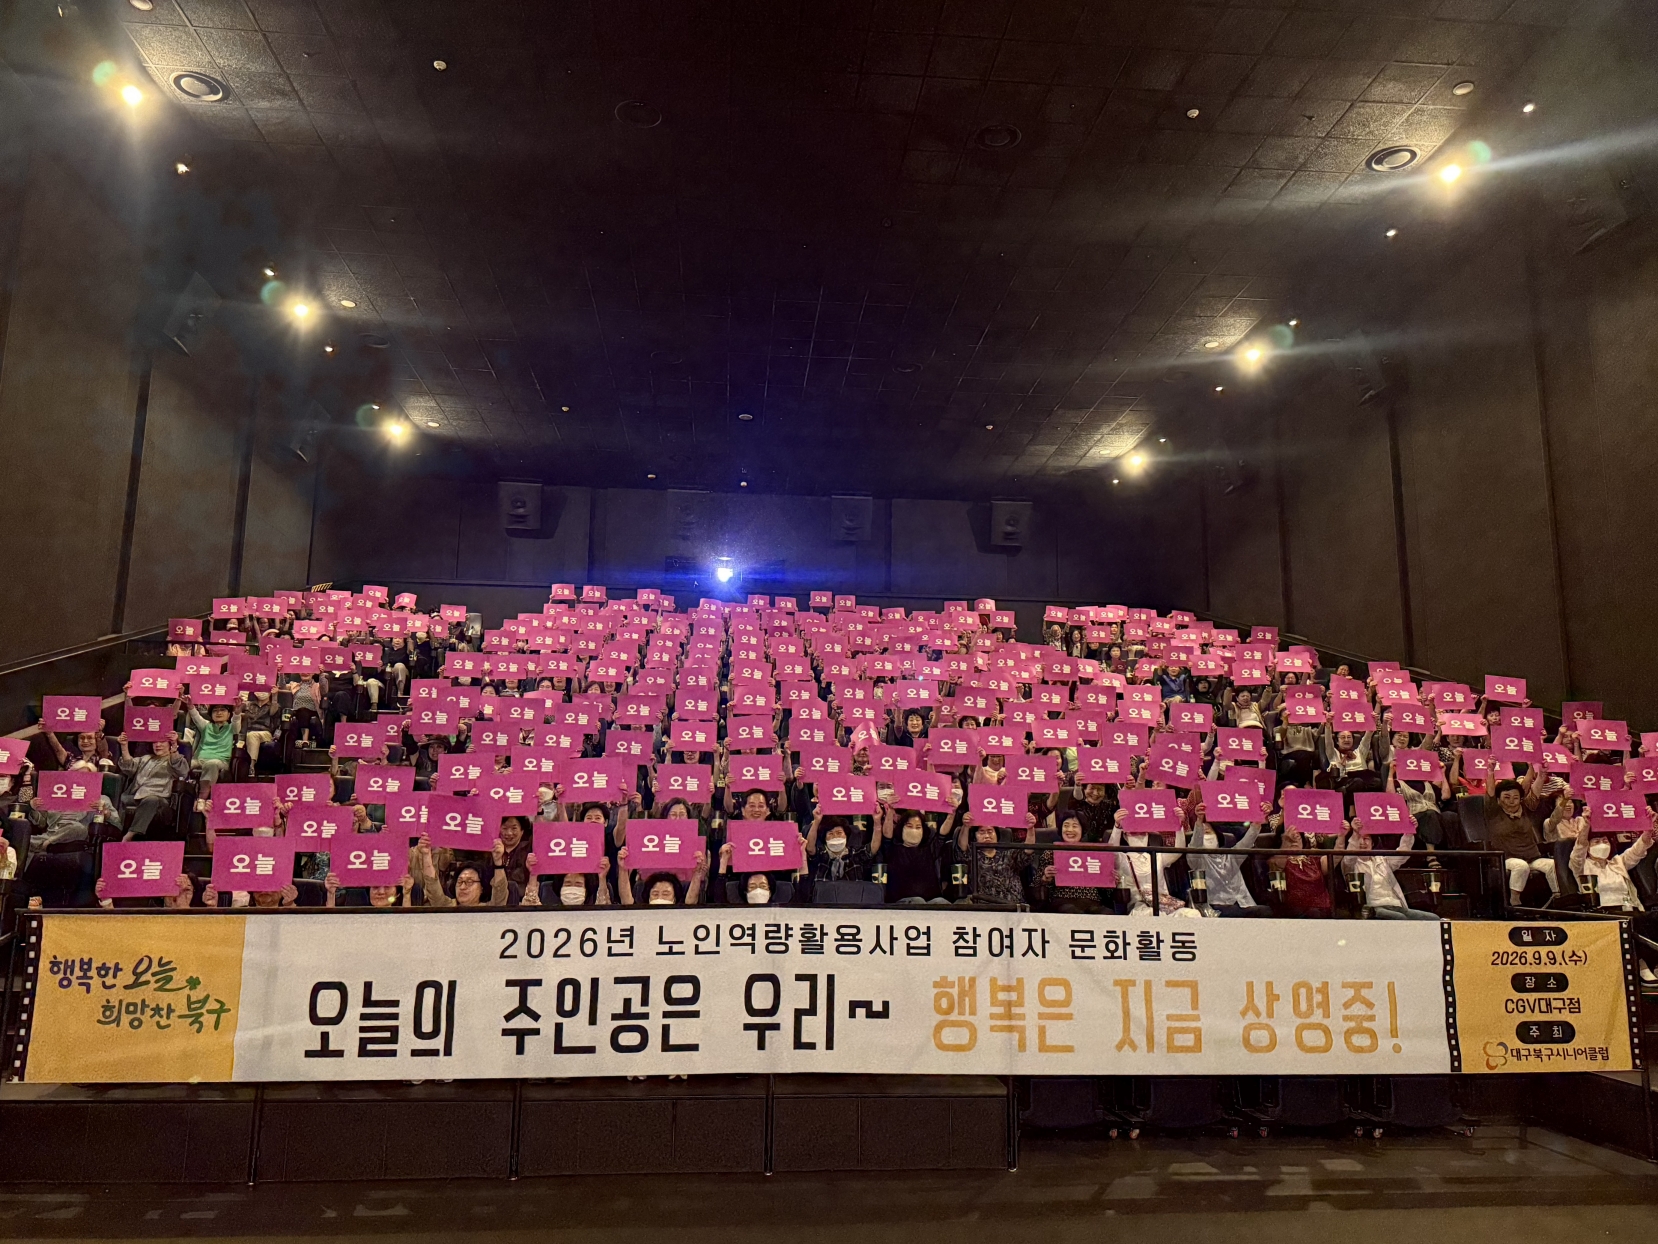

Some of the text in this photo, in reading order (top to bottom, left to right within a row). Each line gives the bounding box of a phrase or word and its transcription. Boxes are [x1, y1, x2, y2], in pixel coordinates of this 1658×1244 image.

[220, 604, 238, 612] 오늘
[263, 604, 280, 612] 오늘
[176, 626, 194, 635] 오늘
[492, 637, 509, 645] 오늘
[579, 641, 596, 649] 오늘
[741, 636, 757, 644] 오늘
[779, 645, 796, 653] 오늘
[825, 643, 842, 652] 오늘
[290, 656, 312, 666] 오늘
[355, 652, 373, 660] 오늘
[610, 652, 628, 660] 오늘
[739, 651, 756, 659] 오늘
[1244, 651, 1262, 659] 오늘
[453, 660, 474, 669] 오늘
[498, 663, 518, 672] 오늘
[548, 661, 568, 670] 오늘
[875, 662, 892, 670] 오늘
[949, 661, 967, 670] 오늘
[1284, 658, 1302, 666] 오늘
[186, 665, 211, 674] 오늘
[597, 667, 617, 675] 오늘
[742, 668, 762, 679] 오늘
[784, 665, 803, 673] 오늘
[831, 665, 849, 675] 오늘
[1052, 664, 1071, 673] 오늘
[1242, 669, 1261, 677] 오늘
[141, 678, 169, 689] 오늘
[243, 673, 266, 684] 오늘
[687, 675, 707, 685] 오늘
[200, 684, 227, 695] 오늘
[989, 680, 1008, 690] 오늘
[1495, 684, 1517, 695] 오늘
[789, 690, 810, 699] 오늘
[844, 688, 864, 699] 오늘
[907, 689, 929, 698] 오늘
[1040, 693, 1061, 703] 오늘
[1087, 693, 1107, 704] 오늘
[1133, 693, 1152, 701] 오늘
[1340, 690, 1358, 699] 오늘
[1389, 690, 1410, 699] 오늘
[1443, 692, 1464, 702] 오늘
[685, 700, 708, 711] 오늘
[743, 695, 766, 706] 오늘
[964, 696, 987, 708] 오늘
[56, 708, 87, 721] 오늘
[510, 707, 534, 719] 오늘
[627, 704, 650, 715] 오늘
[799, 708, 821, 719] 오늘
[853, 708, 875, 718] 오늘
[1129, 708, 1151, 718] 오늘
[1296, 706, 1316, 715] 오늘
[420, 711, 448, 724] 오늘
[565, 713, 588, 724] 오늘
[1181, 712, 1204, 723] 오늘
[1342, 712, 1365, 722] 오늘
[1402, 713, 1424, 725] 오늘
[1511, 717, 1534, 727] 오늘
[132, 718, 161, 731] 오늘
[1077, 720, 1097, 731] 오늘
[1451, 719, 1474, 730] 오늘
[681, 731, 706, 742] 오늘
[739, 726, 763, 738] 오늘
[800, 729, 825, 742] 오늘
[1043, 728, 1068, 739] 오늘
[1591, 729, 1617, 741] 오늘
[345, 734, 373, 747] 오늘
[481, 732, 508, 745] 오늘
[544, 735, 572, 747] 오늘
[988, 736, 1013, 746] 오늘
[1113, 733, 1138, 745] 오늘
[1229, 738, 1253, 750] 오늘
[1505, 737, 1533, 752] 오늘
[616, 741, 642, 754] 오늘
[940, 739, 967, 753] 오늘
[880, 757, 908, 769] 오늘
[1543, 752, 1568, 764] 오늘
[523, 758, 554, 772] 오늘
[811, 758, 840, 772] 오늘
[1091, 759, 1119, 772] 오늘
[1160, 759, 1189, 777] 오늘
[1406, 759, 1431, 771] 오늘
[450, 765, 482, 779] 오늘
[742, 766, 771, 780] 오늘
[1018, 767, 1045, 781] 오늘
[368, 778, 400, 792] 오늘
[573, 771, 608, 788] 오늘
[669, 776, 699, 791] 오늘
[1583, 776, 1612, 790] 오늘
[52, 784, 86, 799] 오늘
[285, 786, 316, 801] 오늘
[490, 787, 524, 803] 오늘
[832, 787, 864, 802] 오늘
[907, 783, 939, 800] 오늘
[224, 797, 261, 814] 오늘
[983, 798, 1014, 814] 오늘
[1218, 793, 1249, 809] 오늘
[1135, 802, 1165, 818] 오늘
[1298, 804, 1330, 820] 오늘
[1371, 805, 1400, 821] 오늘
[1604, 803, 1635, 818] 오늘
[301, 820, 337, 838] 오늘
[442, 813, 484, 834] 오늘
[548, 838, 588, 857] 오늘
[642, 834, 681, 853] 오늘
[748, 838, 785, 856] 오늘
[230, 854, 275, 874] 오늘
[348, 850, 391, 870] 오늘
[1069, 857, 1101, 873] 오늘
[118, 859, 162, 879] 오늘
[499, 923, 1198, 962] 2026년 노인역량활용사업 참여자 문화활동
[1491, 950, 1588, 966] 2026.9.9.(수)
[49, 955, 190, 994] 행복한 오늘
[1504, 997, 1581, 1014] CGV대구점
[96, 993, 232, 1034] 희망찬 북구
[304, 979, 457, 1059] 오늘의
[500, 974, 701, 1056] 주인공은
[932, 975, 1075, 1053] 행복은
[1112, 979, 1203, 1054] 지금
[1239, 980, 1402, 1054] 상영중!
[1510, 1046, 1610, 1062] 대구북구시니어클럽
